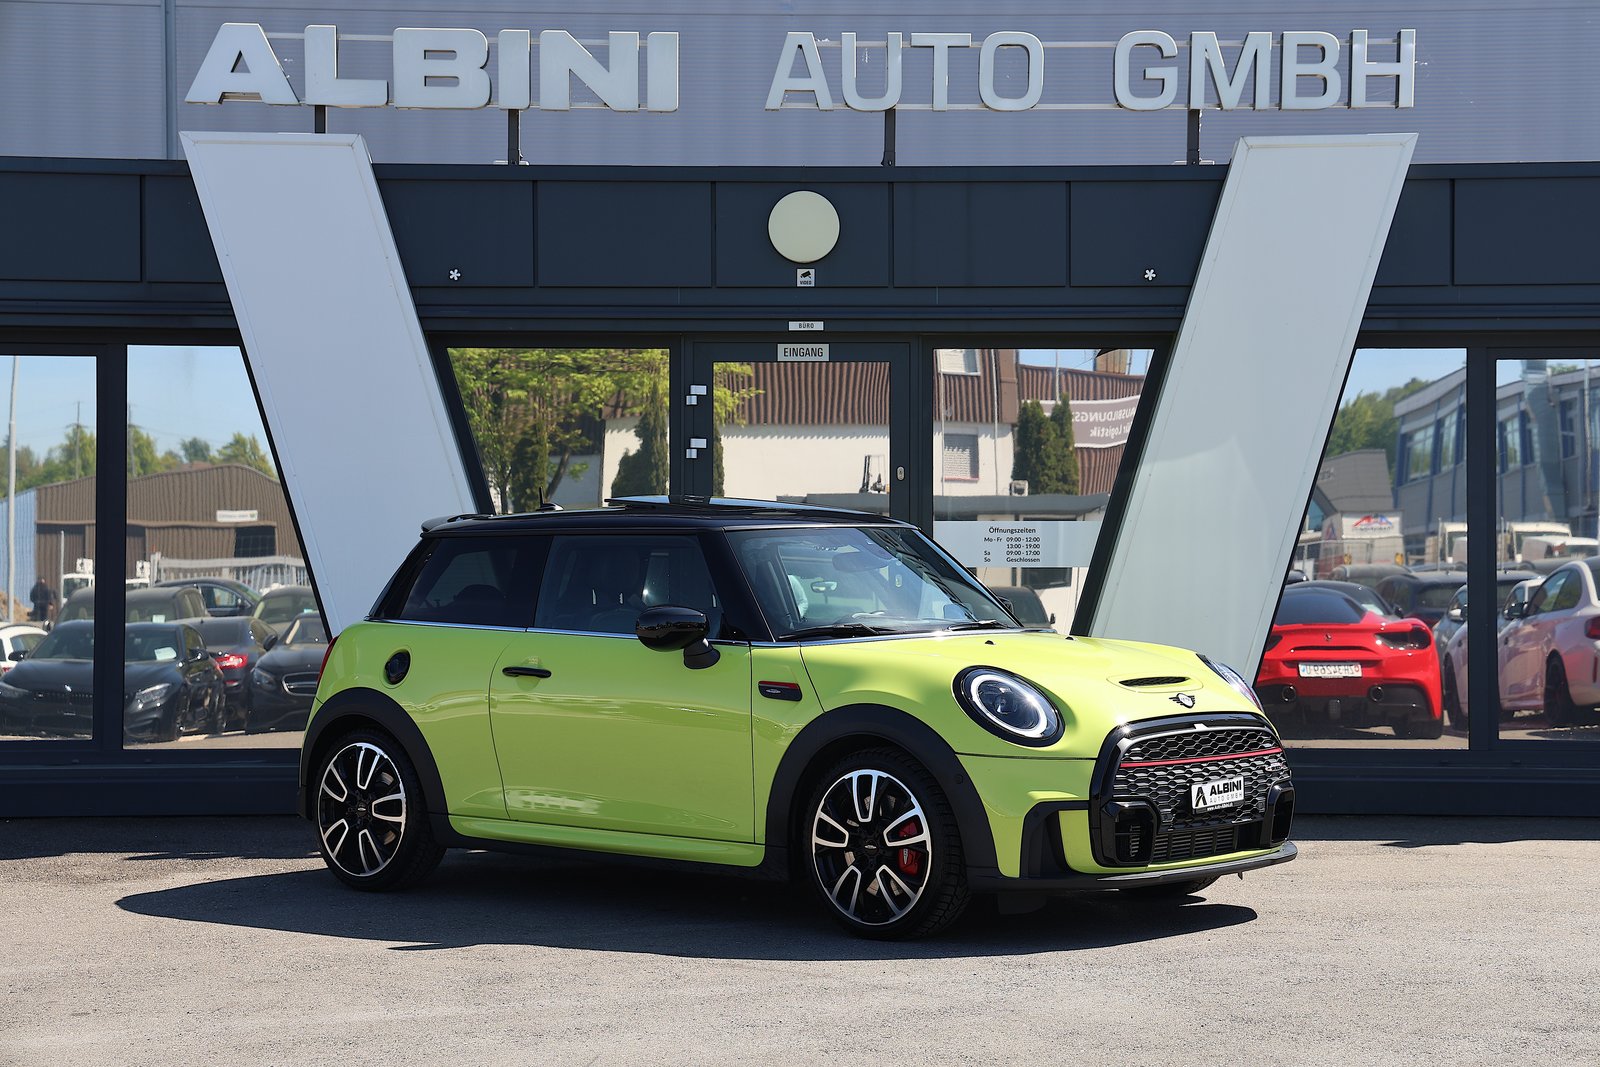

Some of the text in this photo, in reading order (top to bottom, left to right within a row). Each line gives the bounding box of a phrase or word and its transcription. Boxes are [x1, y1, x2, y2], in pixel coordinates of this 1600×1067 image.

[185, 22, 1416, 112] ALBINI AUTO GMBH
[783, 347, 824, 358] EINGANG
[988, 526, 1036, 534] Öffnungszeiten
[1210, 780, 1242, 796] ALBINI
